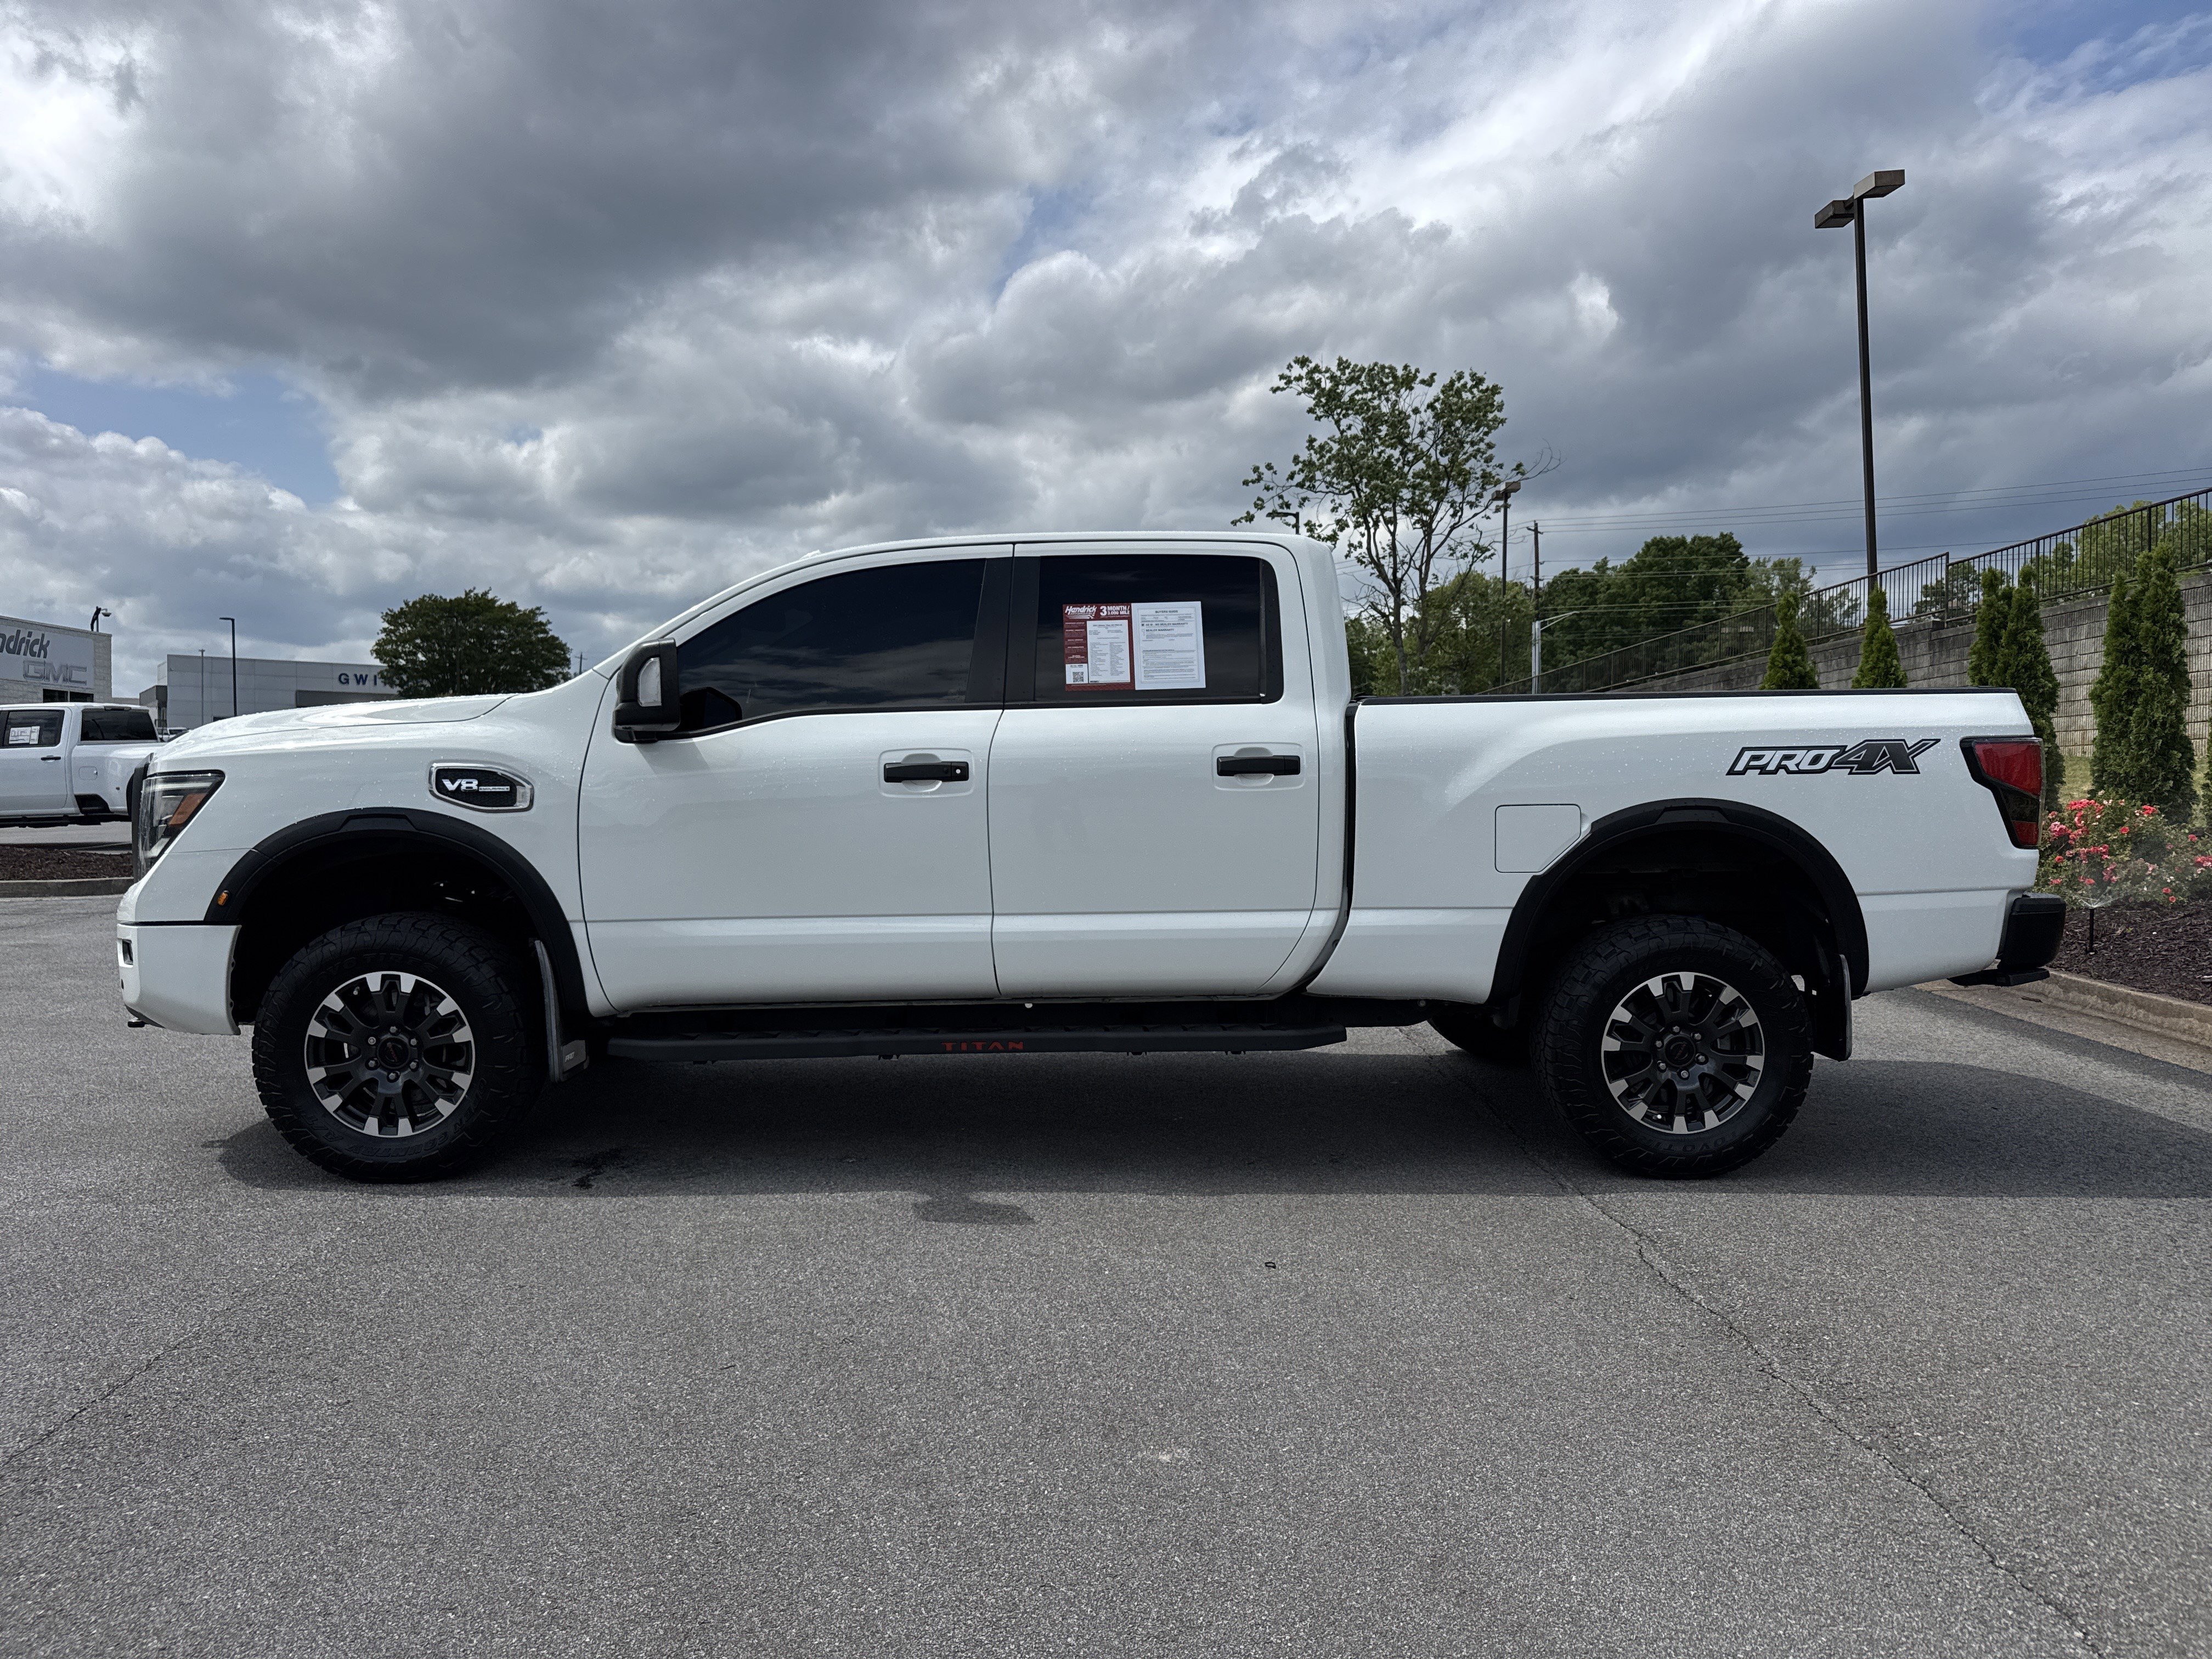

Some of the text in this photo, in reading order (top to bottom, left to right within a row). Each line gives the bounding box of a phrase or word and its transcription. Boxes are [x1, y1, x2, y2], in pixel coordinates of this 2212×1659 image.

[1100, 606, 1107, 616] 3
[23, 660, 87, 685] GMC
[442, 778, 478, 792] V8
[940, 1041, 1024, 1052] TITAN
